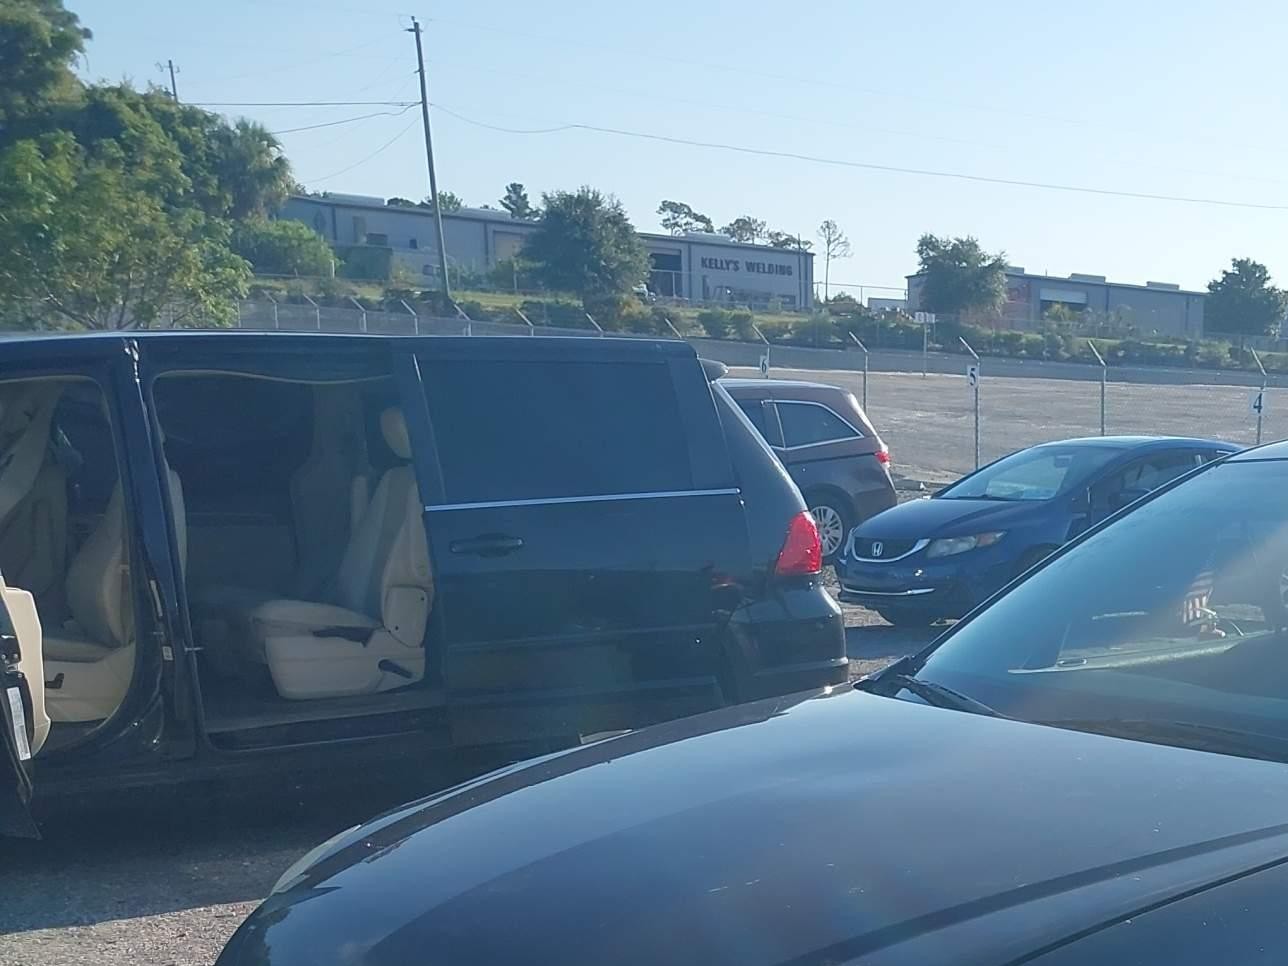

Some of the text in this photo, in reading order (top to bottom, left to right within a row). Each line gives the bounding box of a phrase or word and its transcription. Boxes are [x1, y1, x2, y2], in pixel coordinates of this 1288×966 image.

[700, 257, 793, 276] KELLY'S WELDING
[761, 358, 767, 373] 6
[969, 367, 977, 386] 5
[1253, 393, 1263, 413] 4
